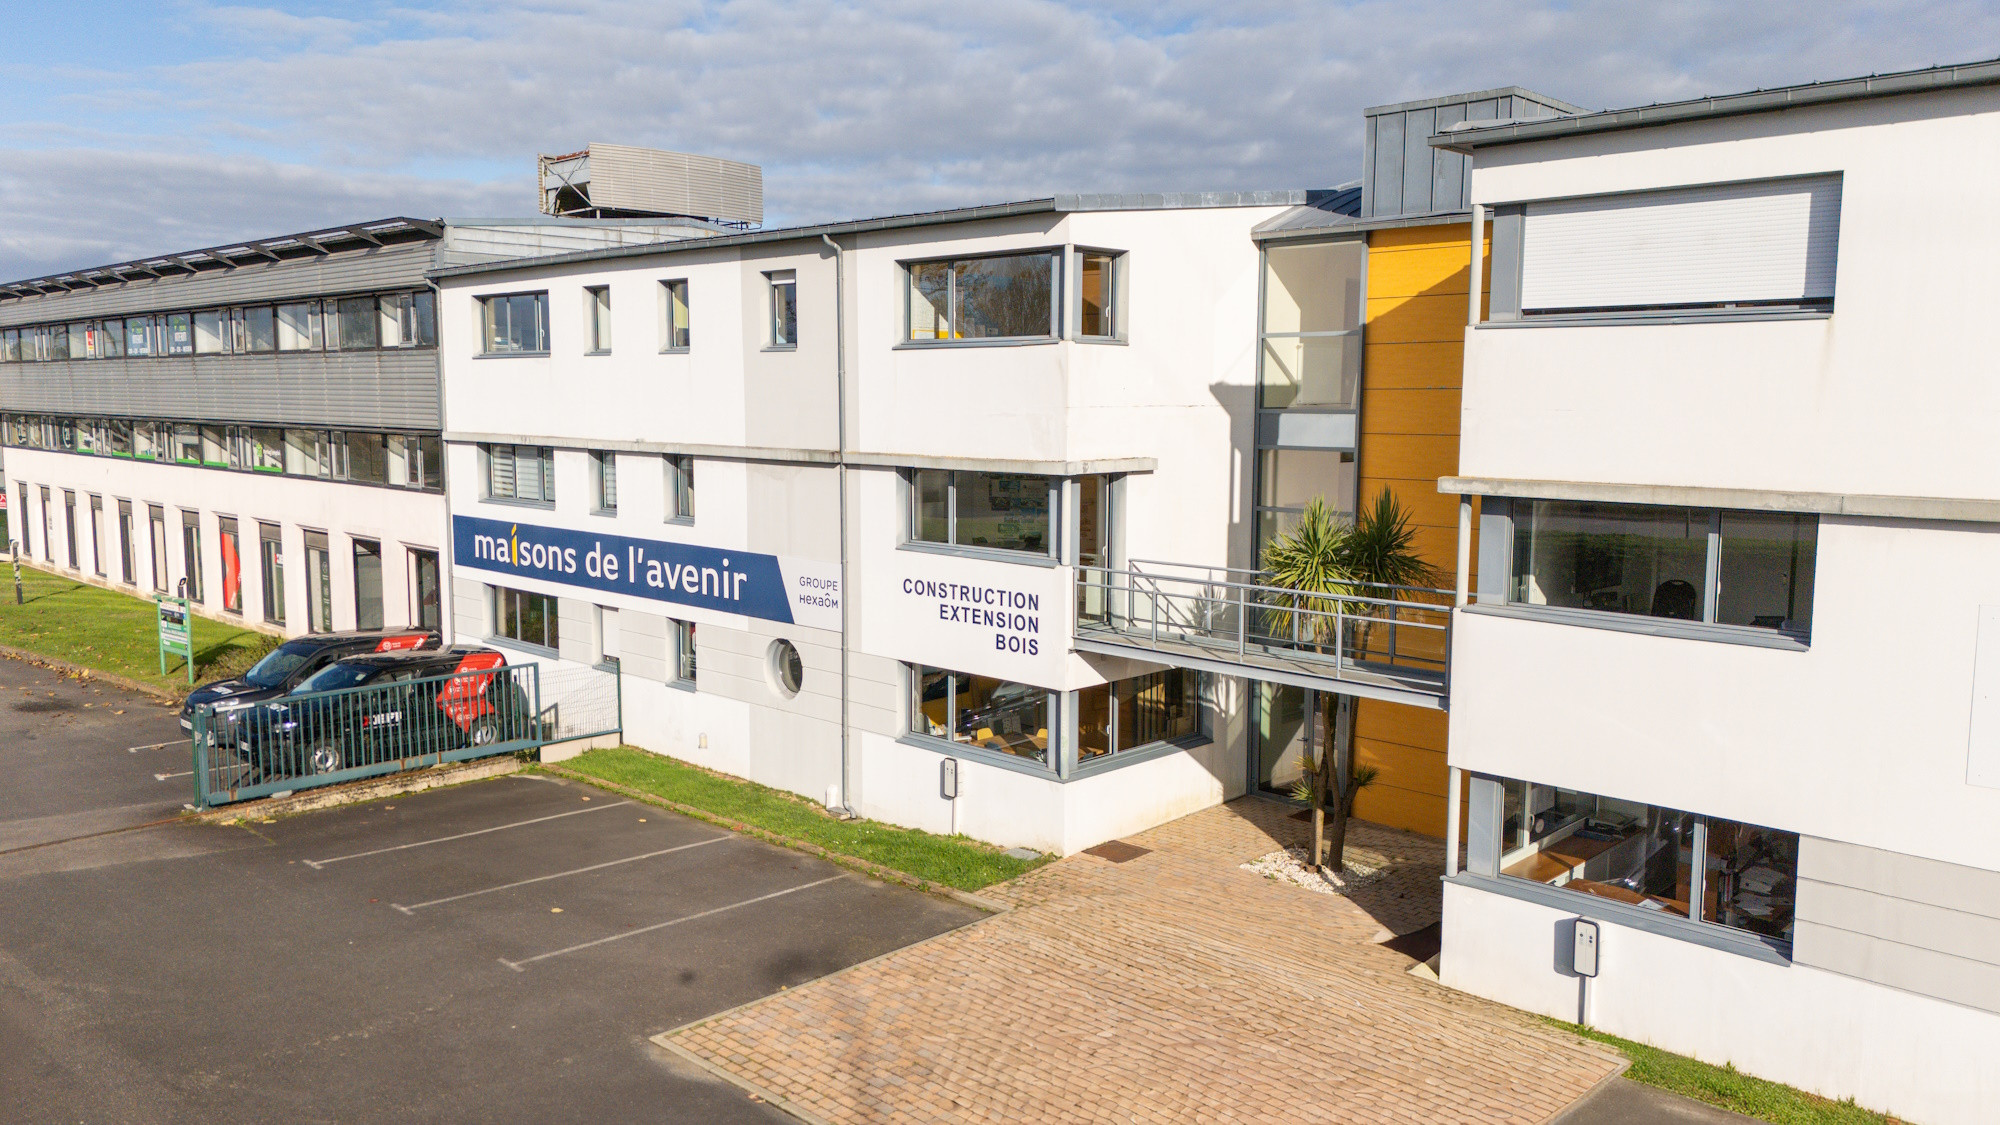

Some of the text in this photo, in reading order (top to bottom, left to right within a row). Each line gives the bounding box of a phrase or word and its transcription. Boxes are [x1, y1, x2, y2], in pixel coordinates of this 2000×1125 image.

[475, 523, 746, 600] maisons de l'avenir
[799, 576, 838, 591] GROUPE
[903, 578, 1039, 611] CONSTRUCTION
[940, 604, 1039, 633] EXTENSION
[996, 634, 1039, 655] BOIS
